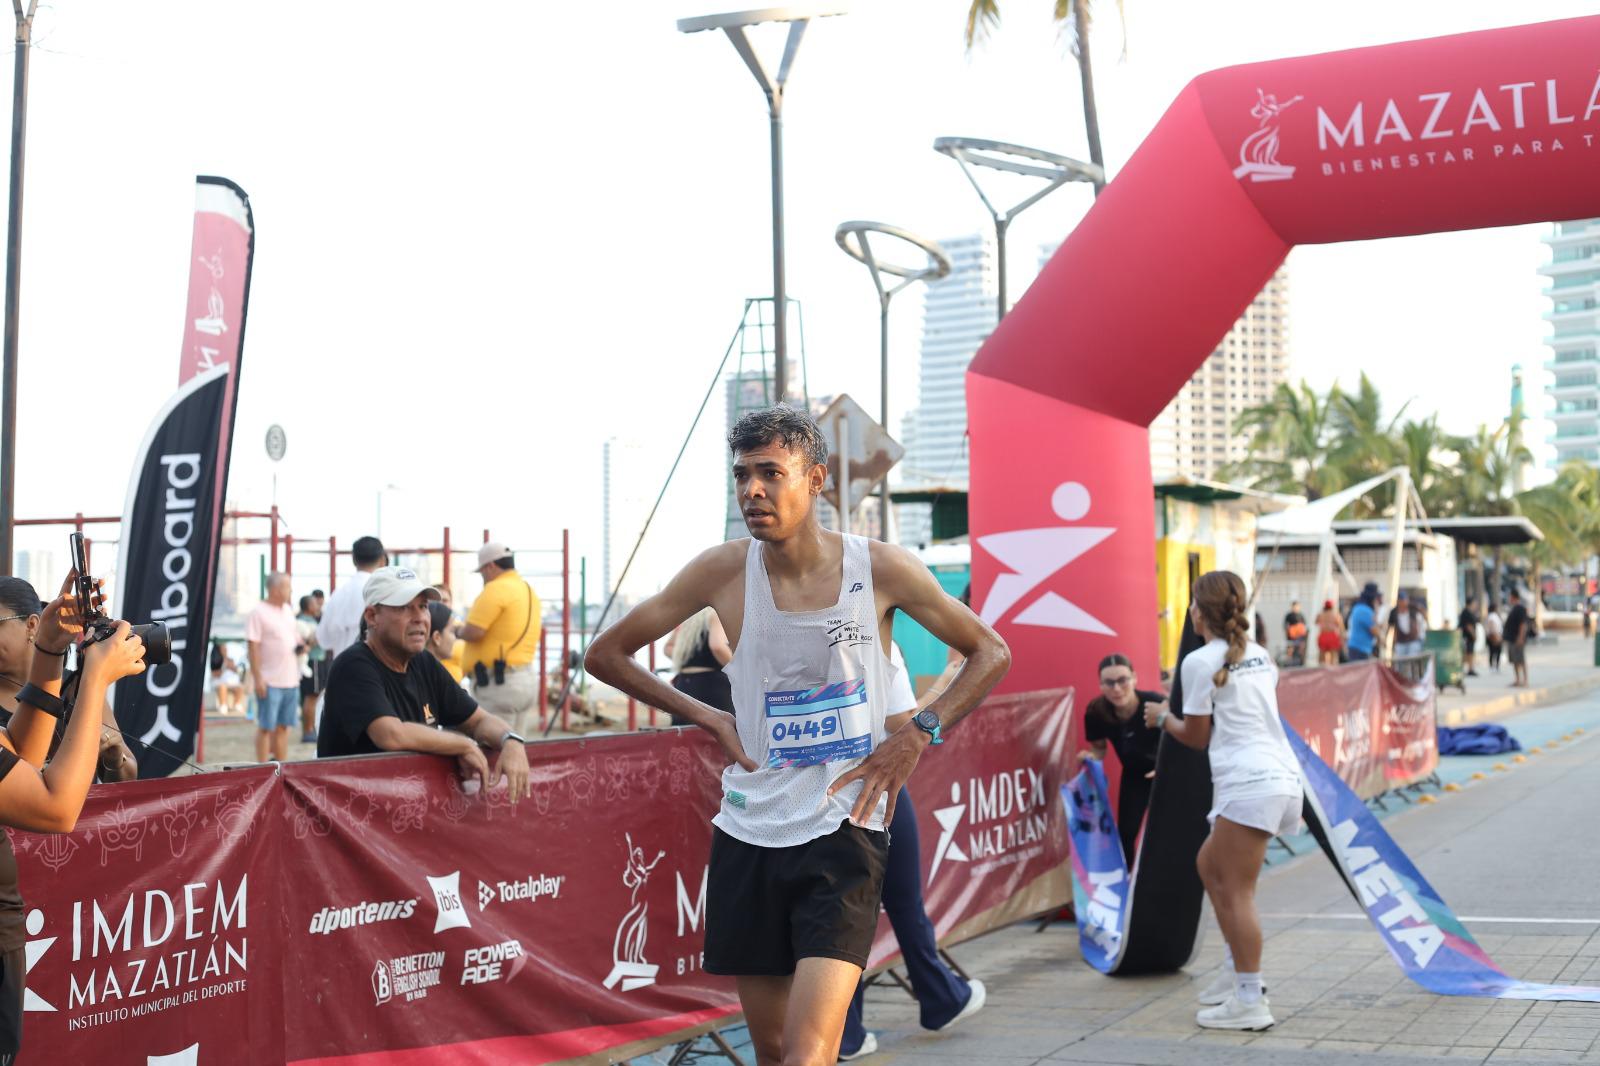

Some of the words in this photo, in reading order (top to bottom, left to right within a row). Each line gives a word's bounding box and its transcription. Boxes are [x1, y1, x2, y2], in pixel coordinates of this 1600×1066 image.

[1321, 148, 1475, 176] BIENESTAR
[1494, 138, 1564, 158] PARA
[772, 715, 837, 741] 0449
[438, 889, 460, 912] ibis
[496, 873, 561, 903] Totalplay
[1329, 818, 1446, 970] META
[72, 873, 248, 962] IMDEM
[309, 899, 418, 935] dportenis
[394, 951, 445, 974] BENETTON
[464, 940, 524, 967] POWER
[68, 934, 248, 1011] MAZATLÁN
[460, 962, 502, 985] ADE
[69, 1007, 129, 1031] INSTITUTO
[131, 997, 180, 1019] MUNICIPAL
[182, 989, 199, 1005] DEL
[201, 979, 248, 1000] DEPORTE
